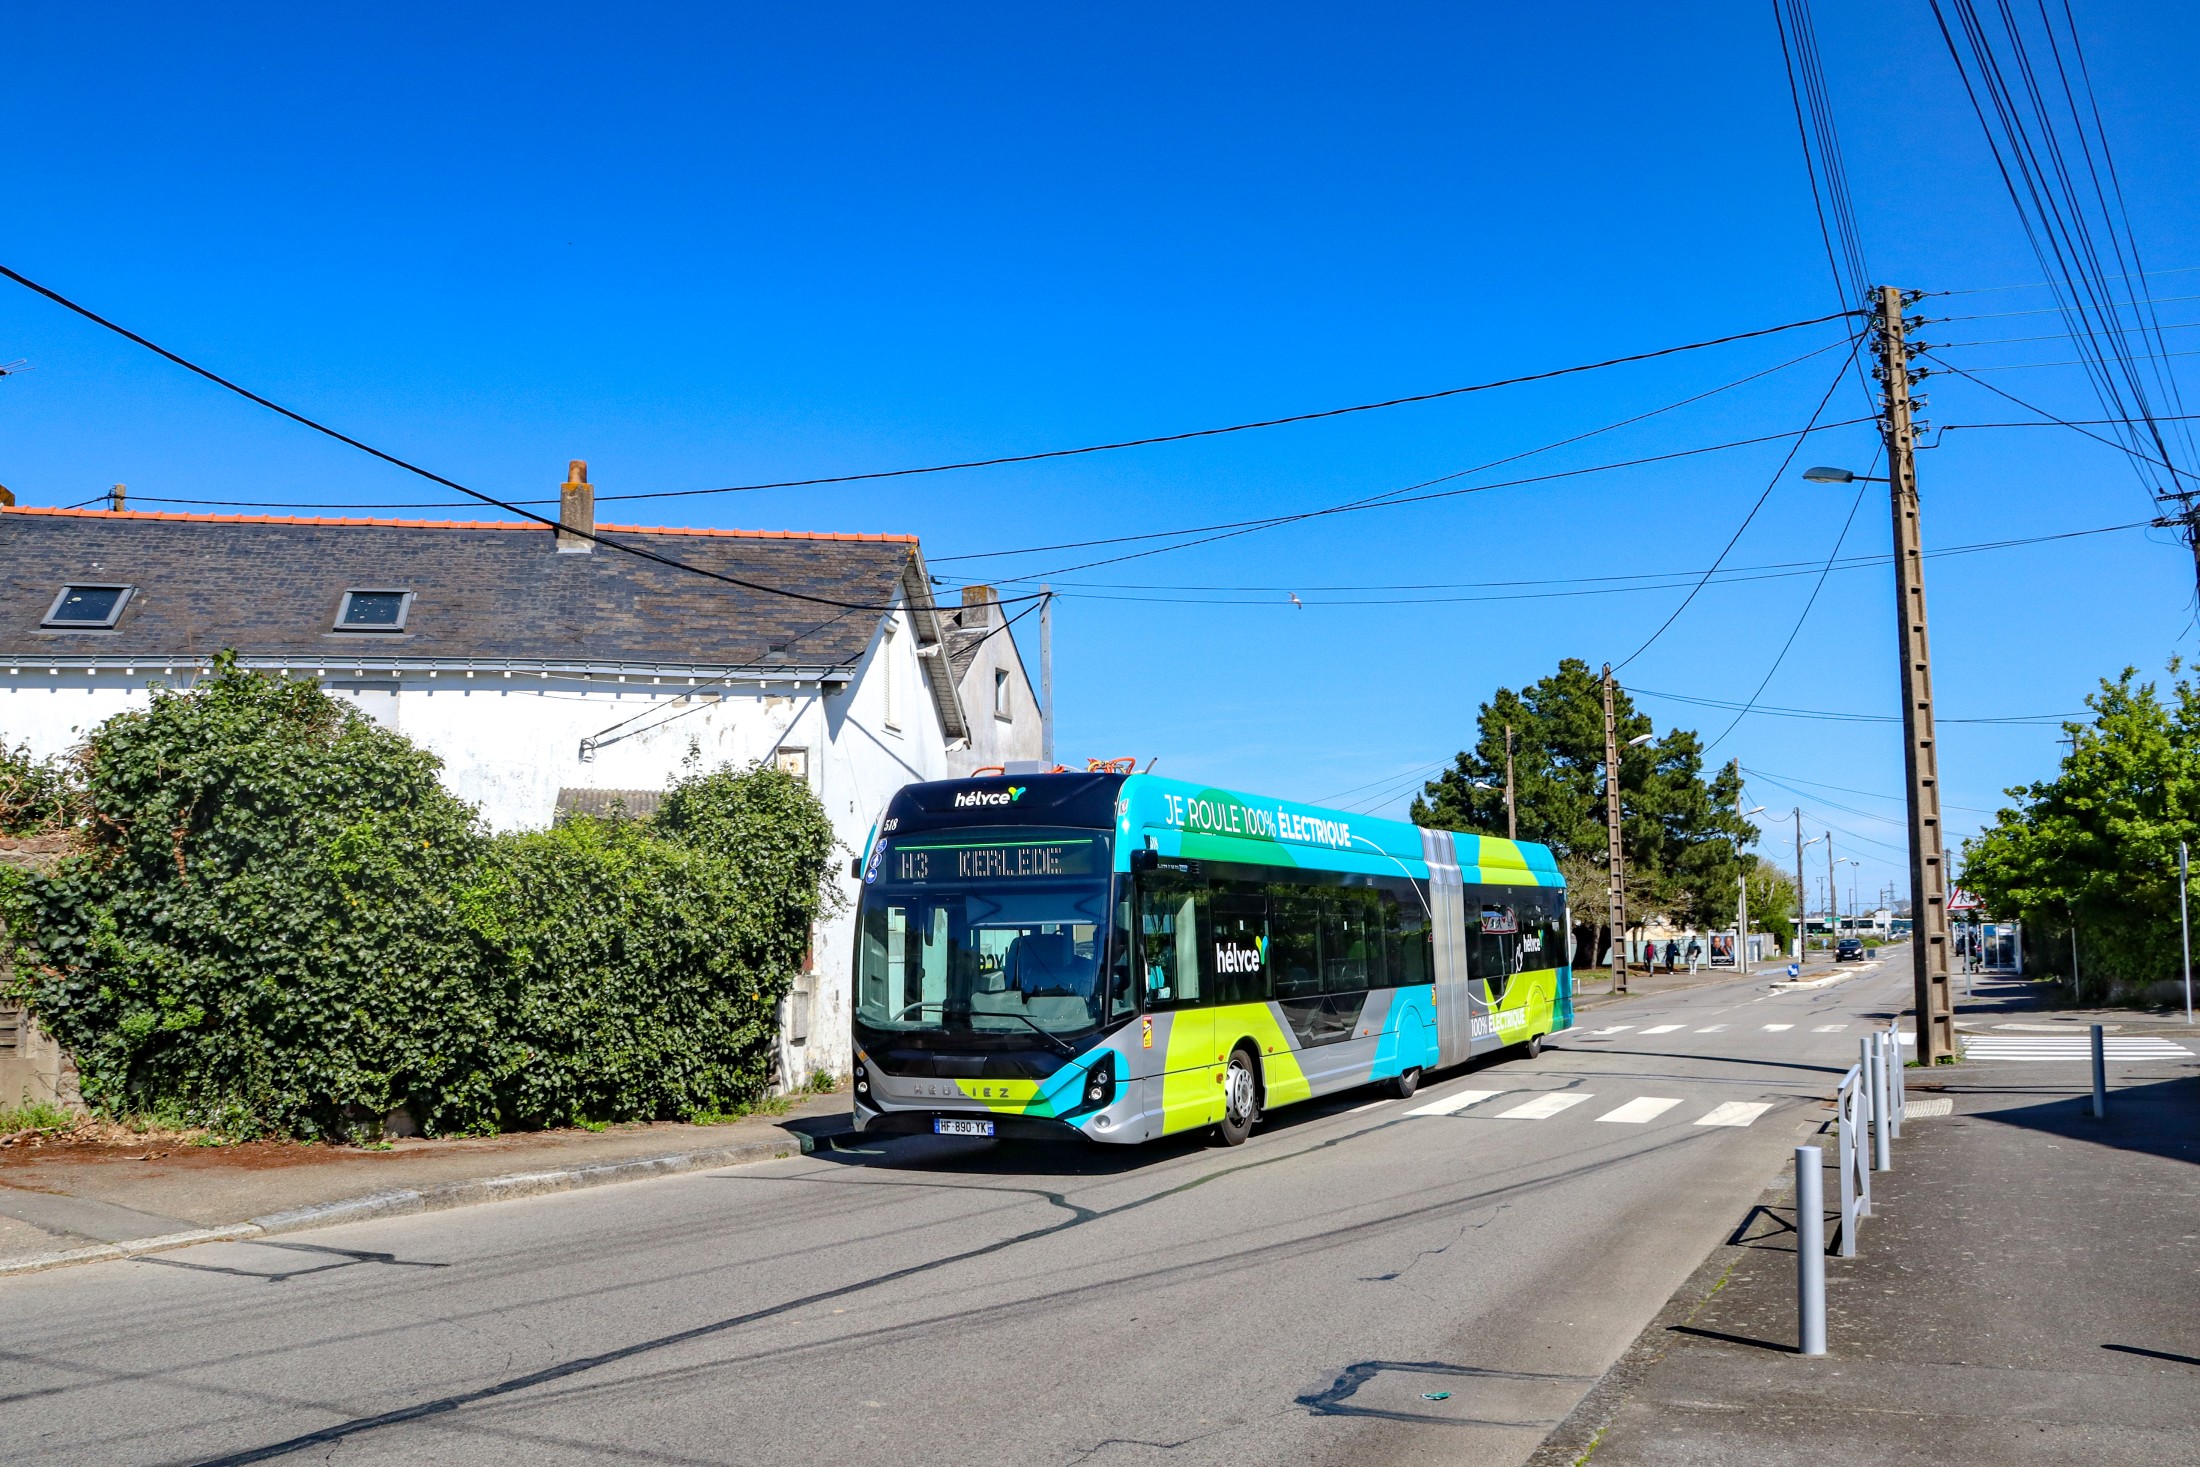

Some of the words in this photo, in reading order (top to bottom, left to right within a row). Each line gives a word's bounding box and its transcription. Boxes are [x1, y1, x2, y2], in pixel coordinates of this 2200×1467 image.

[883, 817, 899, 832] 518
[1164, 795, 1185, 827] JE
[1187, 797, 1241, 833] ROULE
[1241, 806, 1277, 838] 100%
[1277, 805, 1352, 849] ÉLECTRIQUE
[1471, 1016, 1488, 1038] 100%
[914, 1083, 1010, 1098] HEULIEZ
